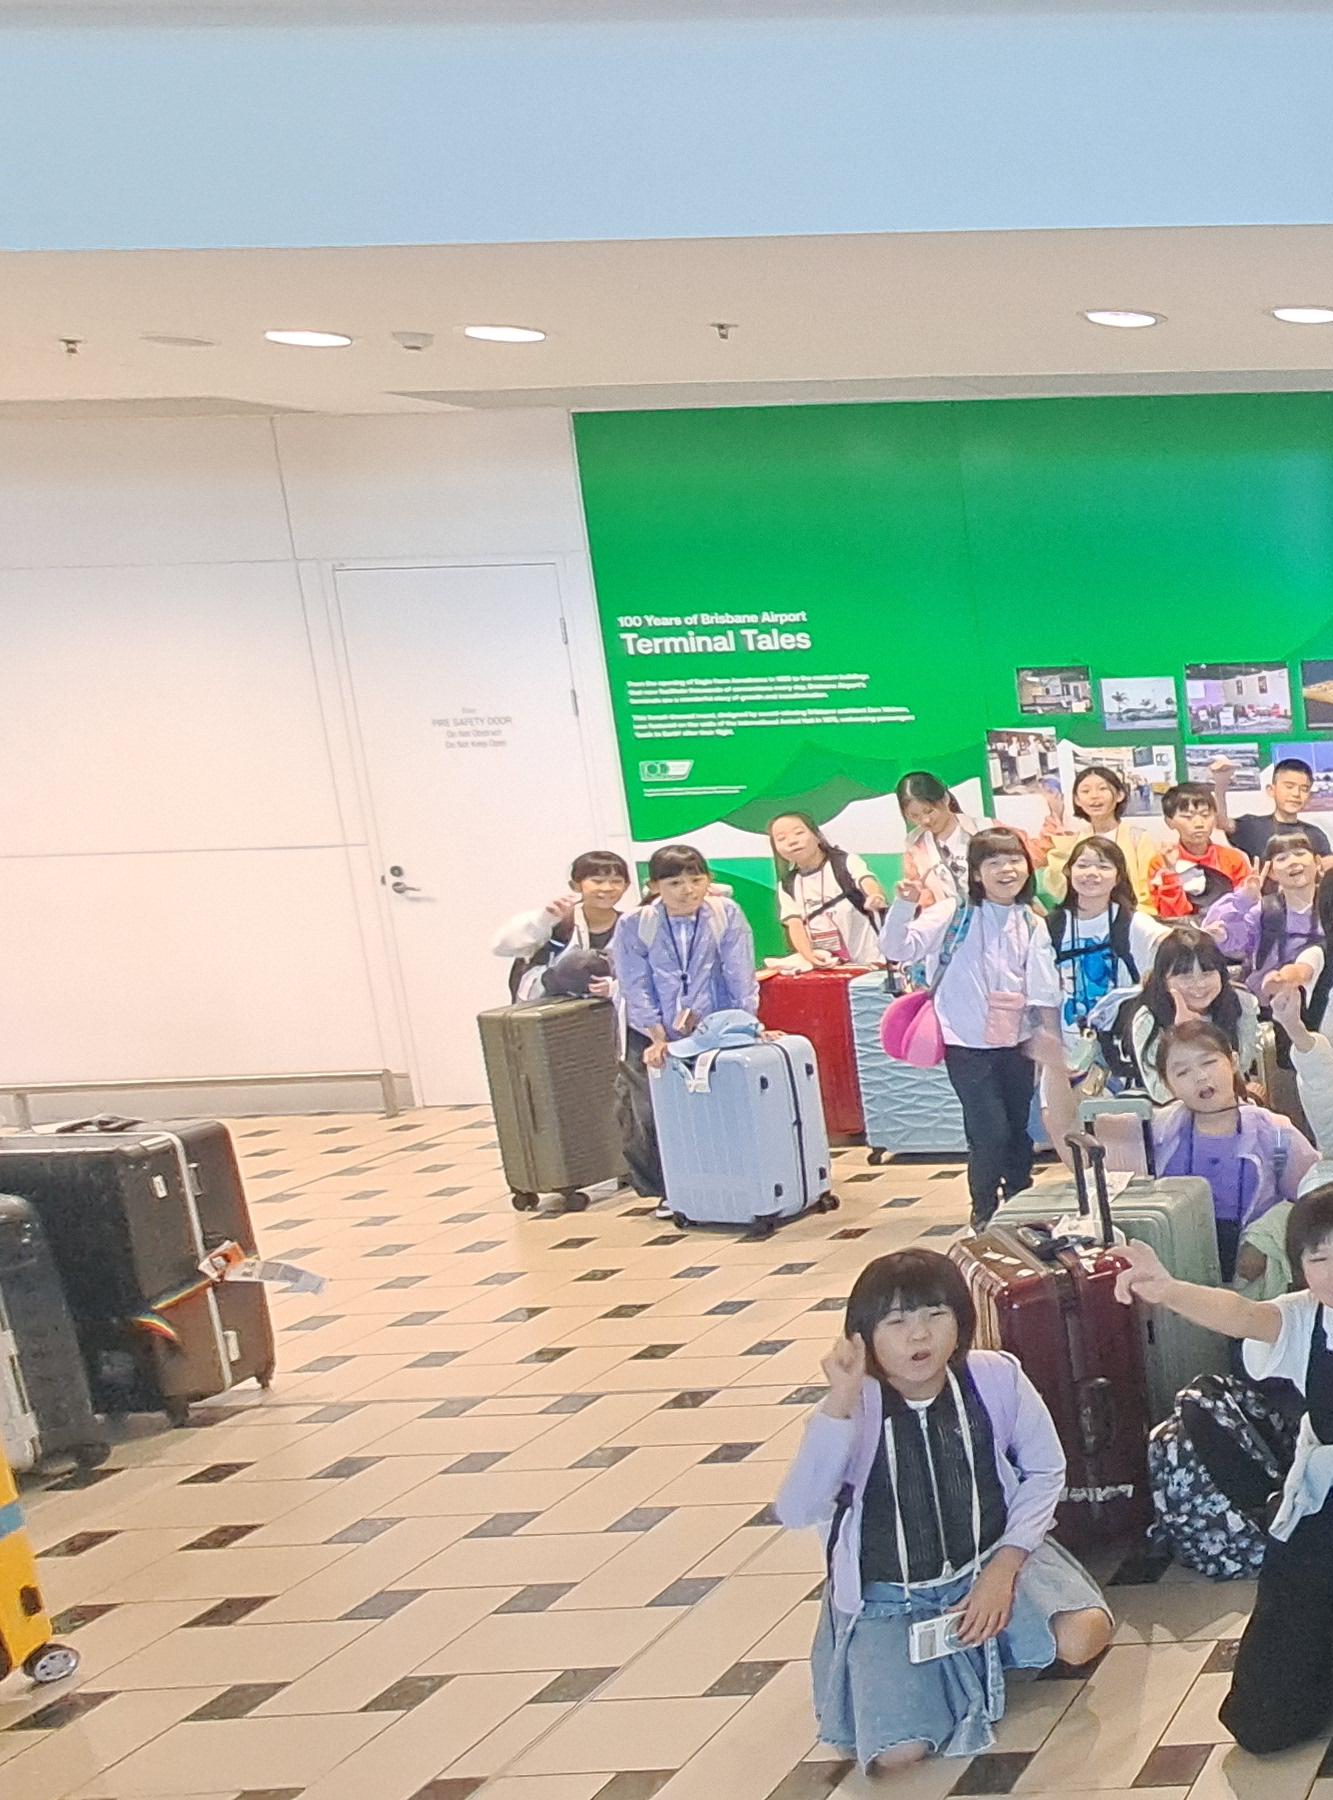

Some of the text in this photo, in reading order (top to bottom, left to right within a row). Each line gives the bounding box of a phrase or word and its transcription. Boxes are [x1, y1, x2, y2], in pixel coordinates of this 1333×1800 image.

[617, 610, 807, 628] 100 Years of Brisbane Airport
[619, 628, 812, 656] Terminal Tales
